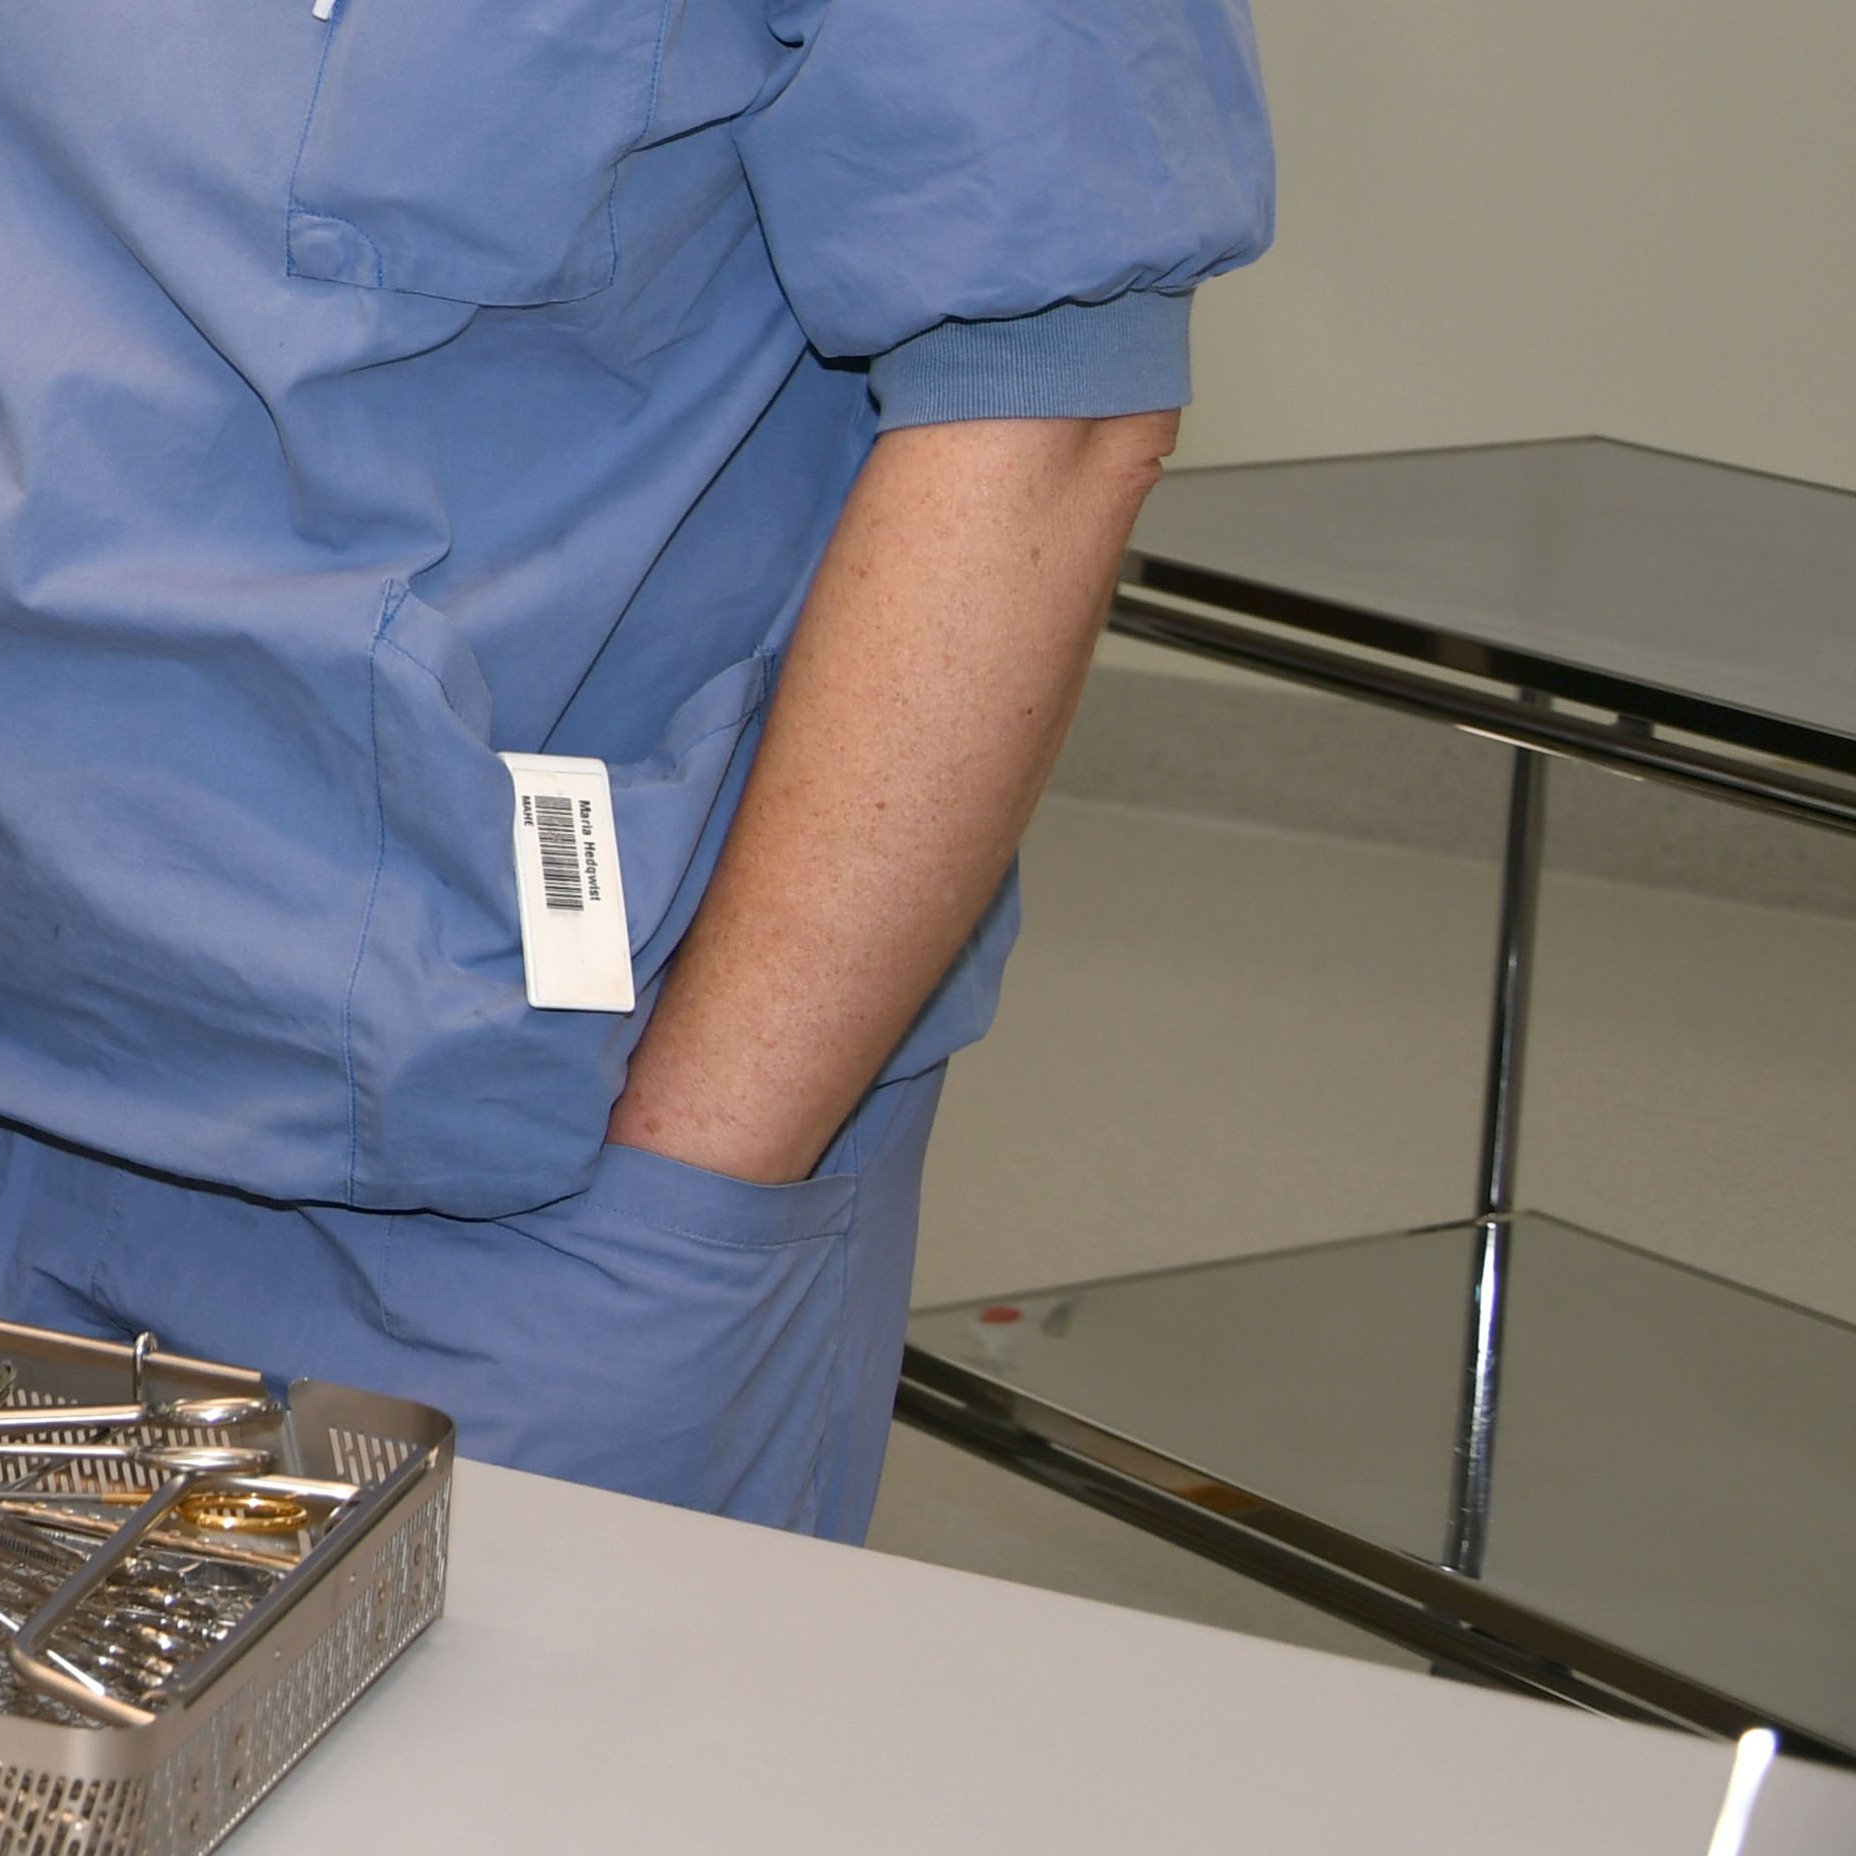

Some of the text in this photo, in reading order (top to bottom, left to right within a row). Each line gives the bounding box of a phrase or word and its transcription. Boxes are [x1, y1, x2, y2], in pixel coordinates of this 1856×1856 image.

[522, 796, 534, 826] MAHE
[578, 799, 601, 901] Maria Hedqwist
